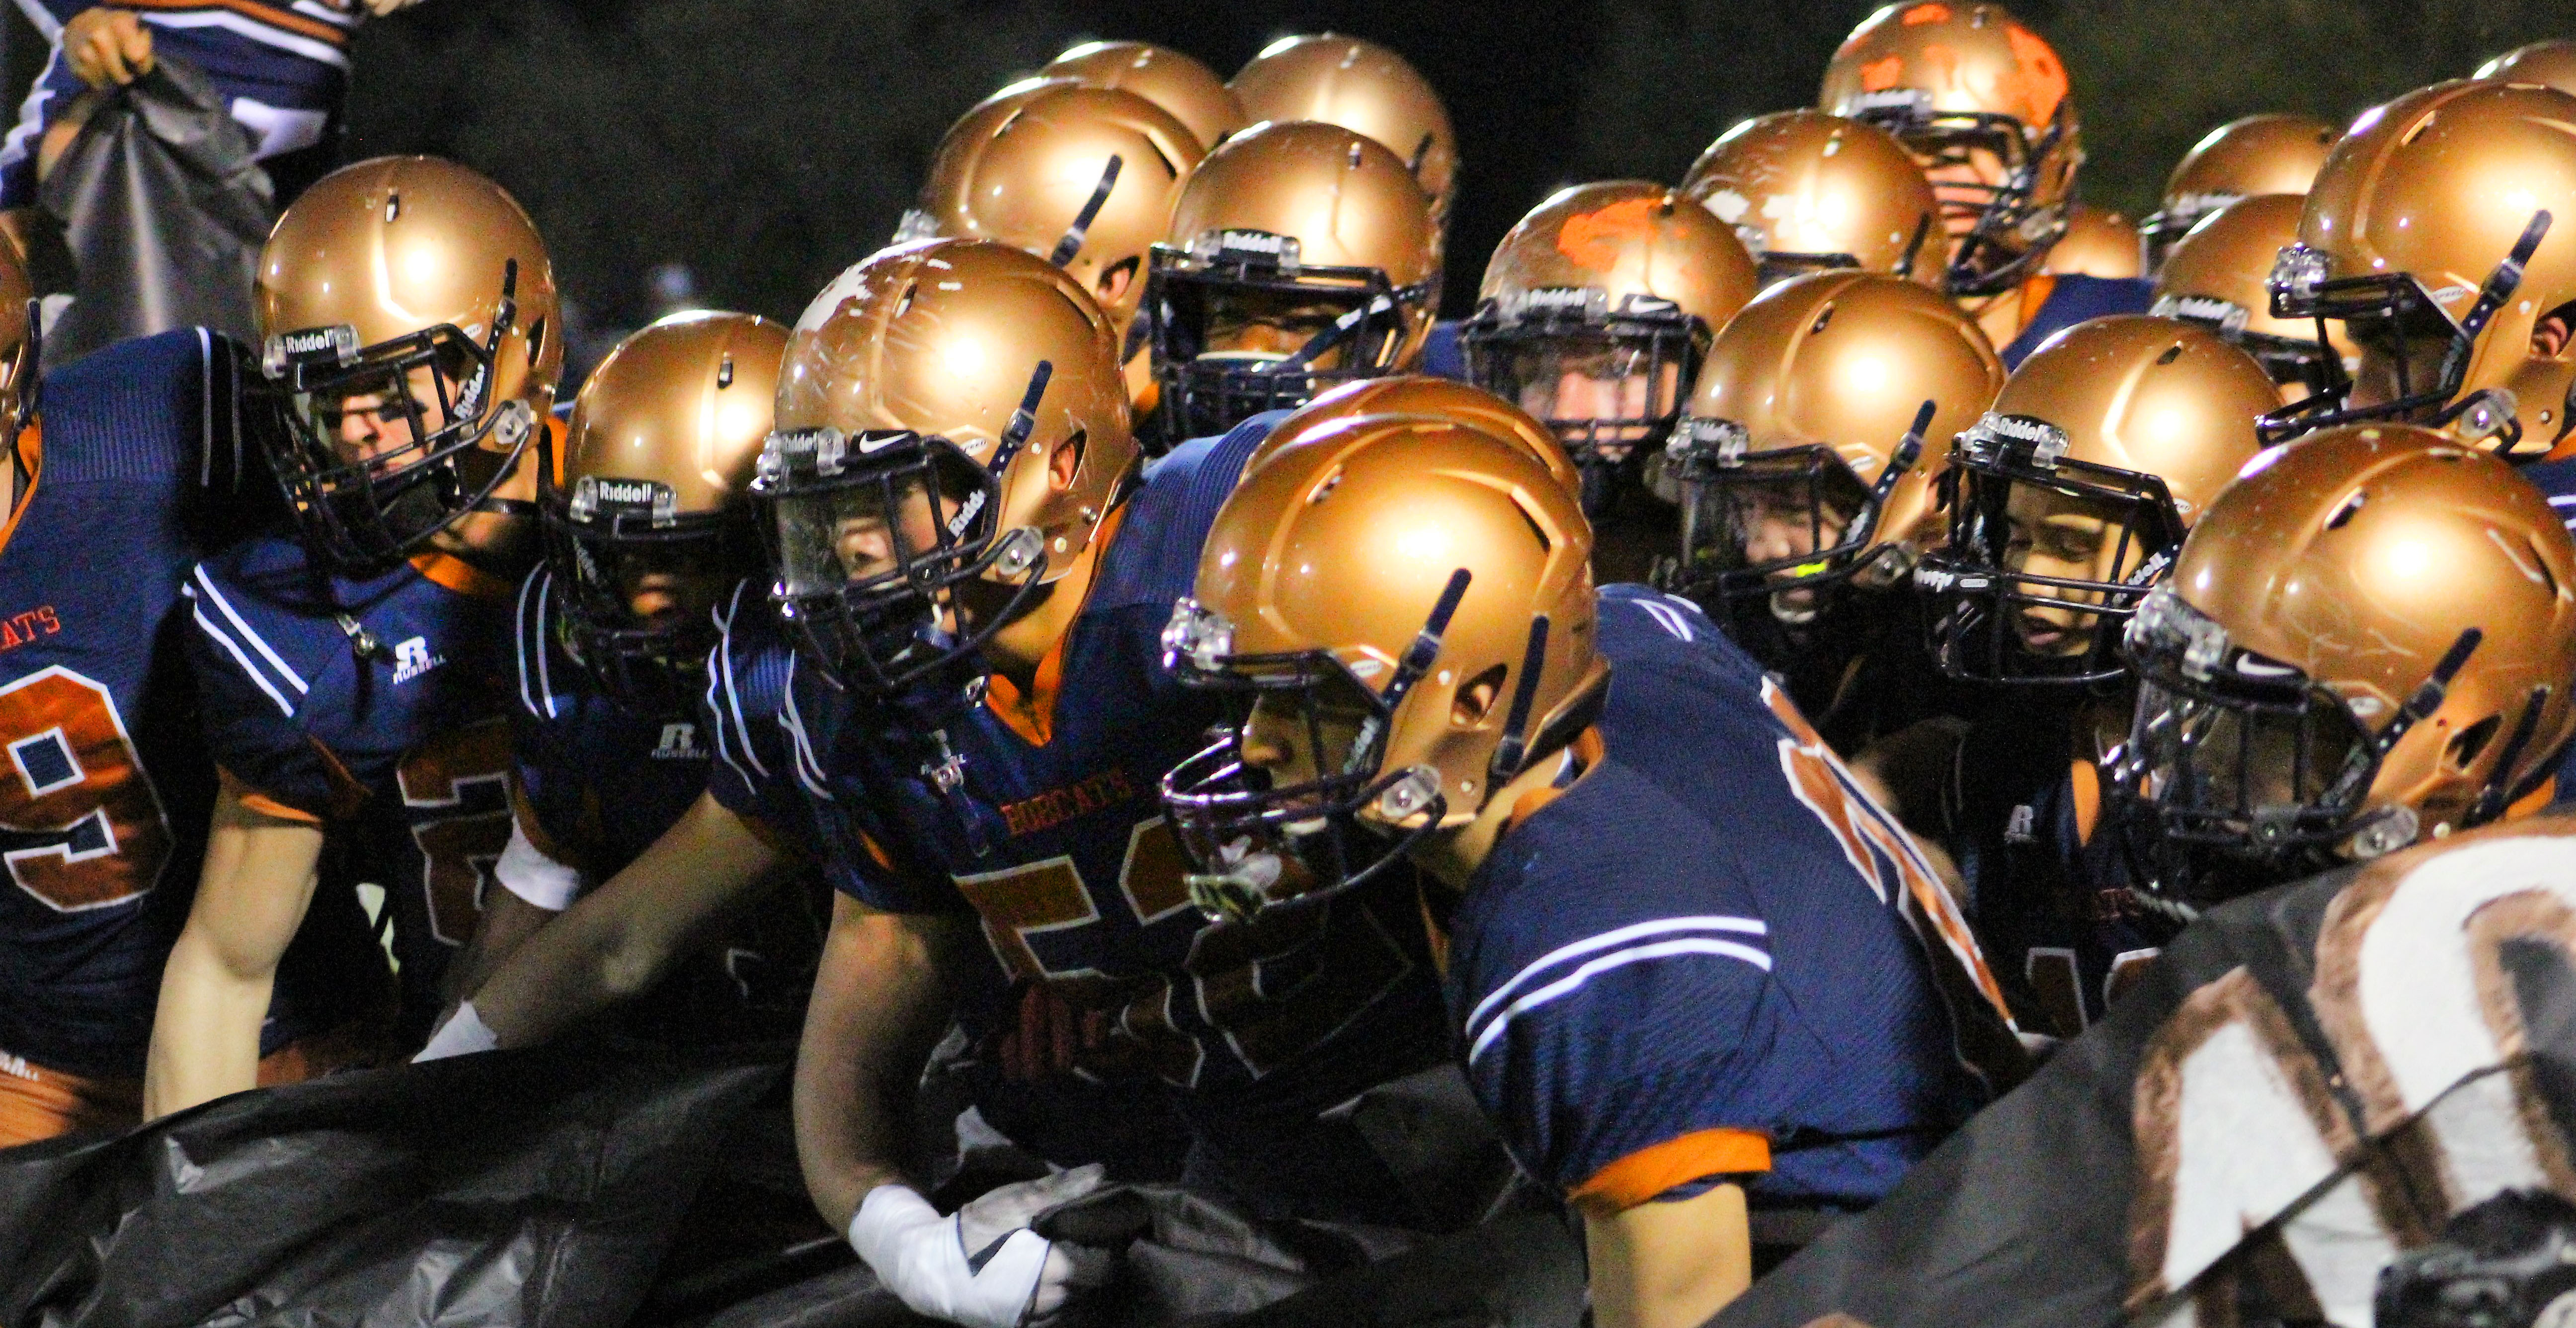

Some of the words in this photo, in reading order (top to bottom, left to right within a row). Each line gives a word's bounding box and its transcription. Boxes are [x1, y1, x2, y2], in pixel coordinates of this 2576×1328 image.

[286, 328, 335, 353] Riddell
[1997, 416, 2050, 442] Riddell
[599, 481, 652, 502] Riddell
